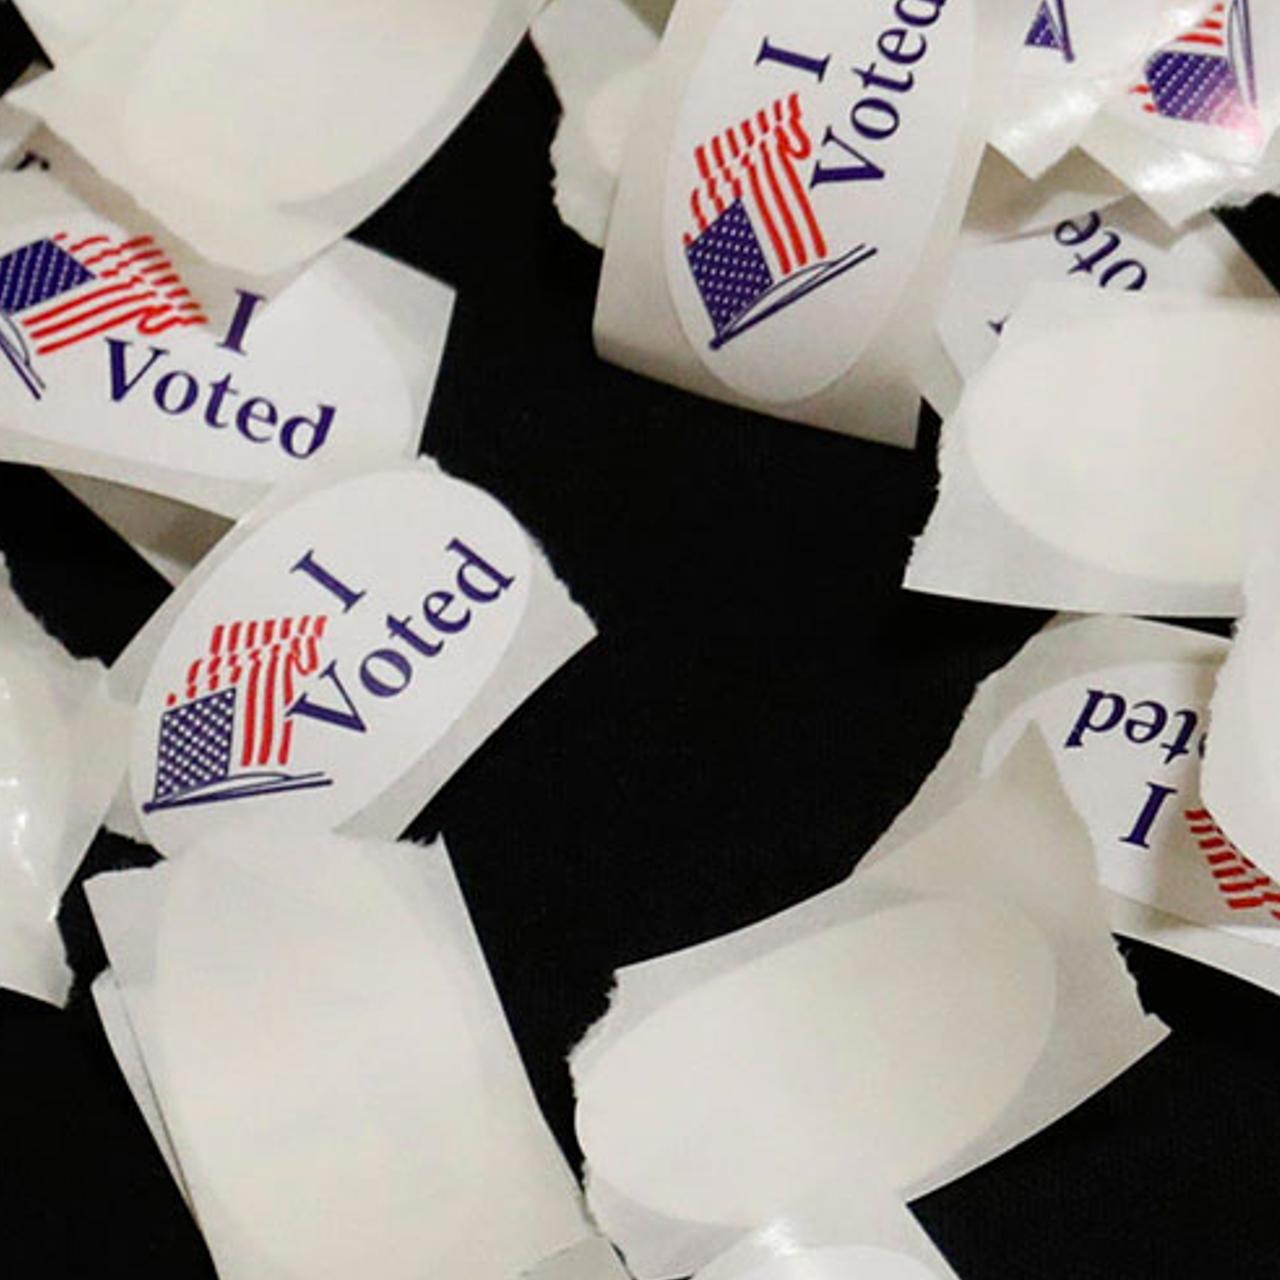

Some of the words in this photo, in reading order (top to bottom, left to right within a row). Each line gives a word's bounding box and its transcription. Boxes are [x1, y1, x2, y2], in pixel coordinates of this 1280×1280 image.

[755, 35, 832, 84] I
[216, 287, 268, 357] I
[103, 336, 338, 460] Voted
[290, 548, 367, 615] I
[286, 536, 517, 732] Voted
[1117, 780, 1179, 851] I
